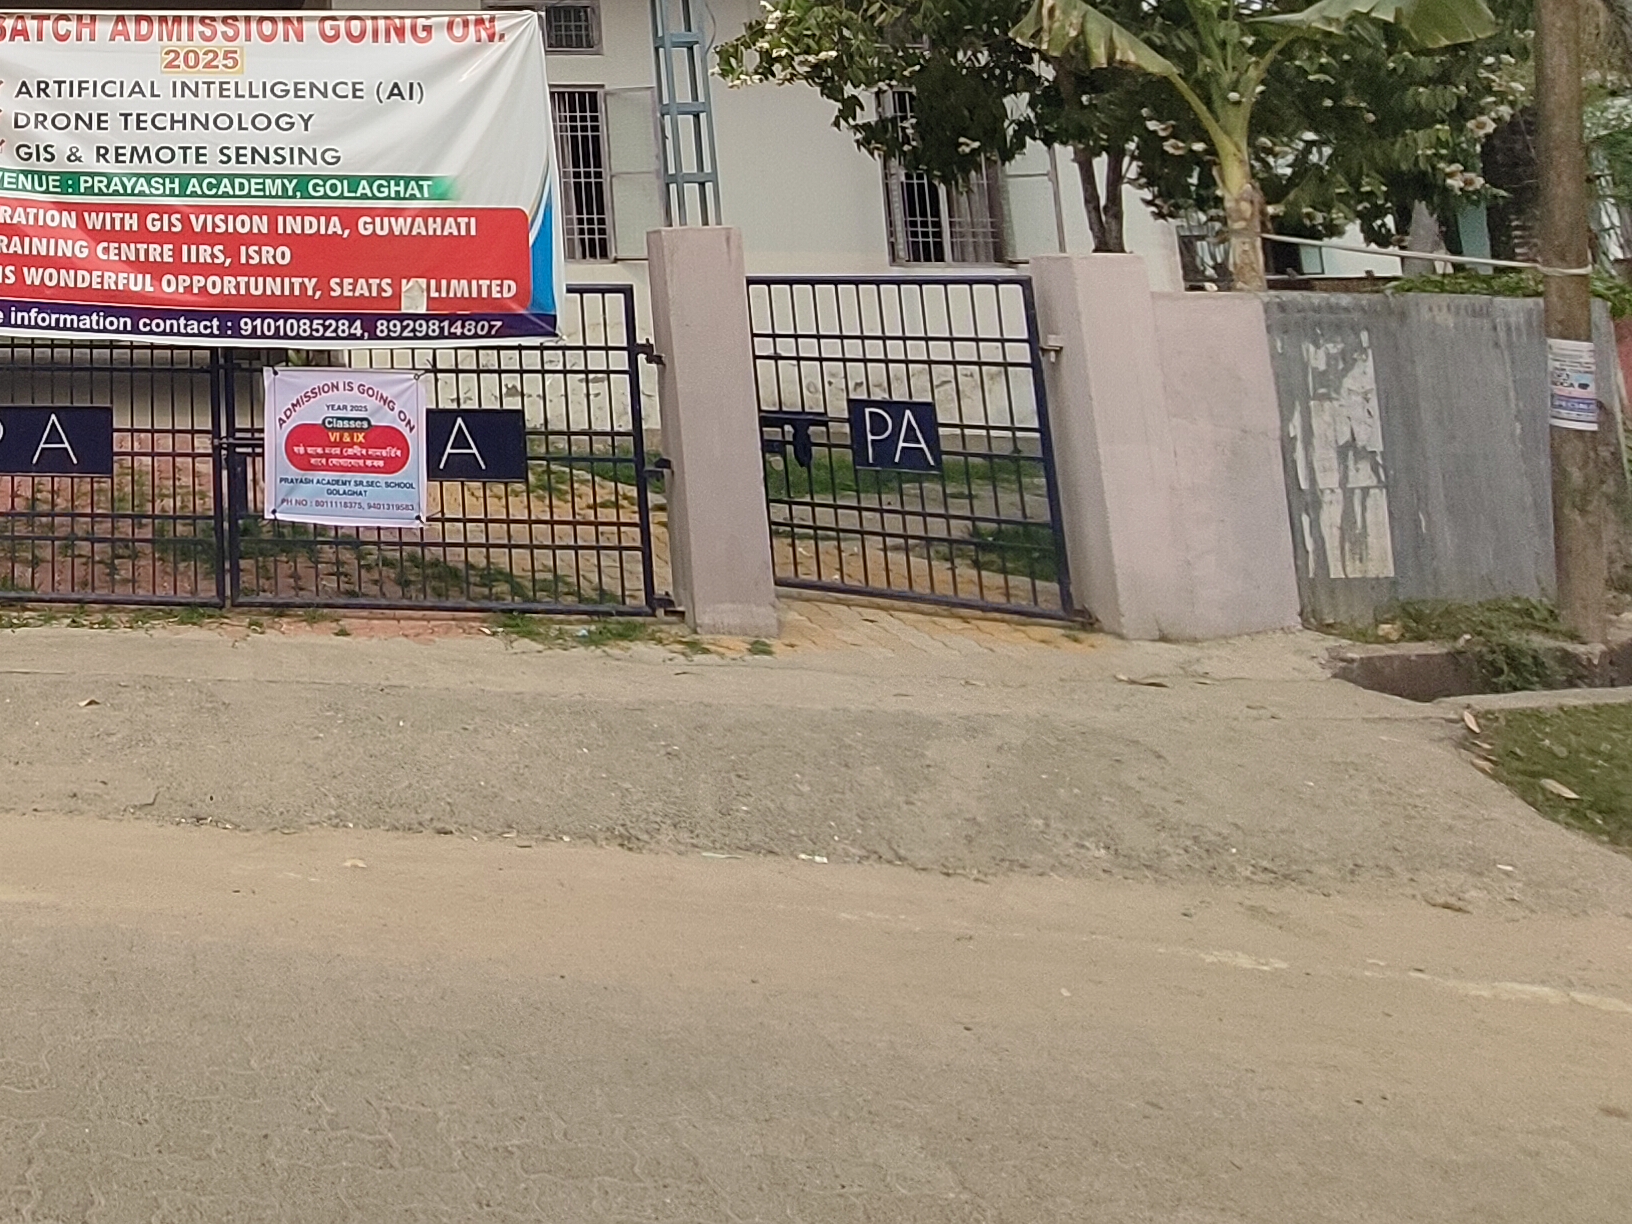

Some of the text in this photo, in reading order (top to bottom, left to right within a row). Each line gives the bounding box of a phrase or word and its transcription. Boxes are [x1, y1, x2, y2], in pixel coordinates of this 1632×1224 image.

[108, 14, 305, 44] ADMISSION
[318, 15, 433, 45] GOING
[162, 48, 240, 70] 2025
[15, 80, 425, 104] ARTIFICIAL INTELLIGENCE (AI)
[13, 112, 315, 132] DRONE TECHNOLOGY
[15, 144, 342, 166] GIS & REMOTE SENSING
[80, 175, 179, 195] PRAYASH
[185, 177, 302, 199] ACADEMY,
[307, 179, 432, 198] GOLAGHAT
[83, 211, 138, 232] WITH
[146, 212, 183, 233] GIS
[189, 213, 268, 234] VISION
[277, 215, 350, 238] INDIA,
[357, 216, 477, 237] GUWAHATI
[96, 241, 174, 263] CENTRE
[182, 244, 232, 266] IIRS,
[239, 244, 292, 265] ISRO
[22, 266, 154, 293] WONDERFUL
[161, 273, 322, 299] OPPORTUNITY,
[329, 277, 393, 297] SEATS
[430, 278, 517, 298] LIMITED
[10, 307, 132, 331] information
[138, 314, 220, 334] contact
[239, 318, 369, 340] 9101085284,
[376, 320, 503, 338] 8929814807
[277, 381, 416, 433] ADMISSION IS GOING ON
[325, 418, 368, 428] Classes
[329, 432, 365, 442] VI & IX
[440, 417, 486, 470] A
[865, 407, 935, 467] PA
[326, 489, 368, 497] GOLAGHAT
[385, 481, 415, 489] SCHOOL
